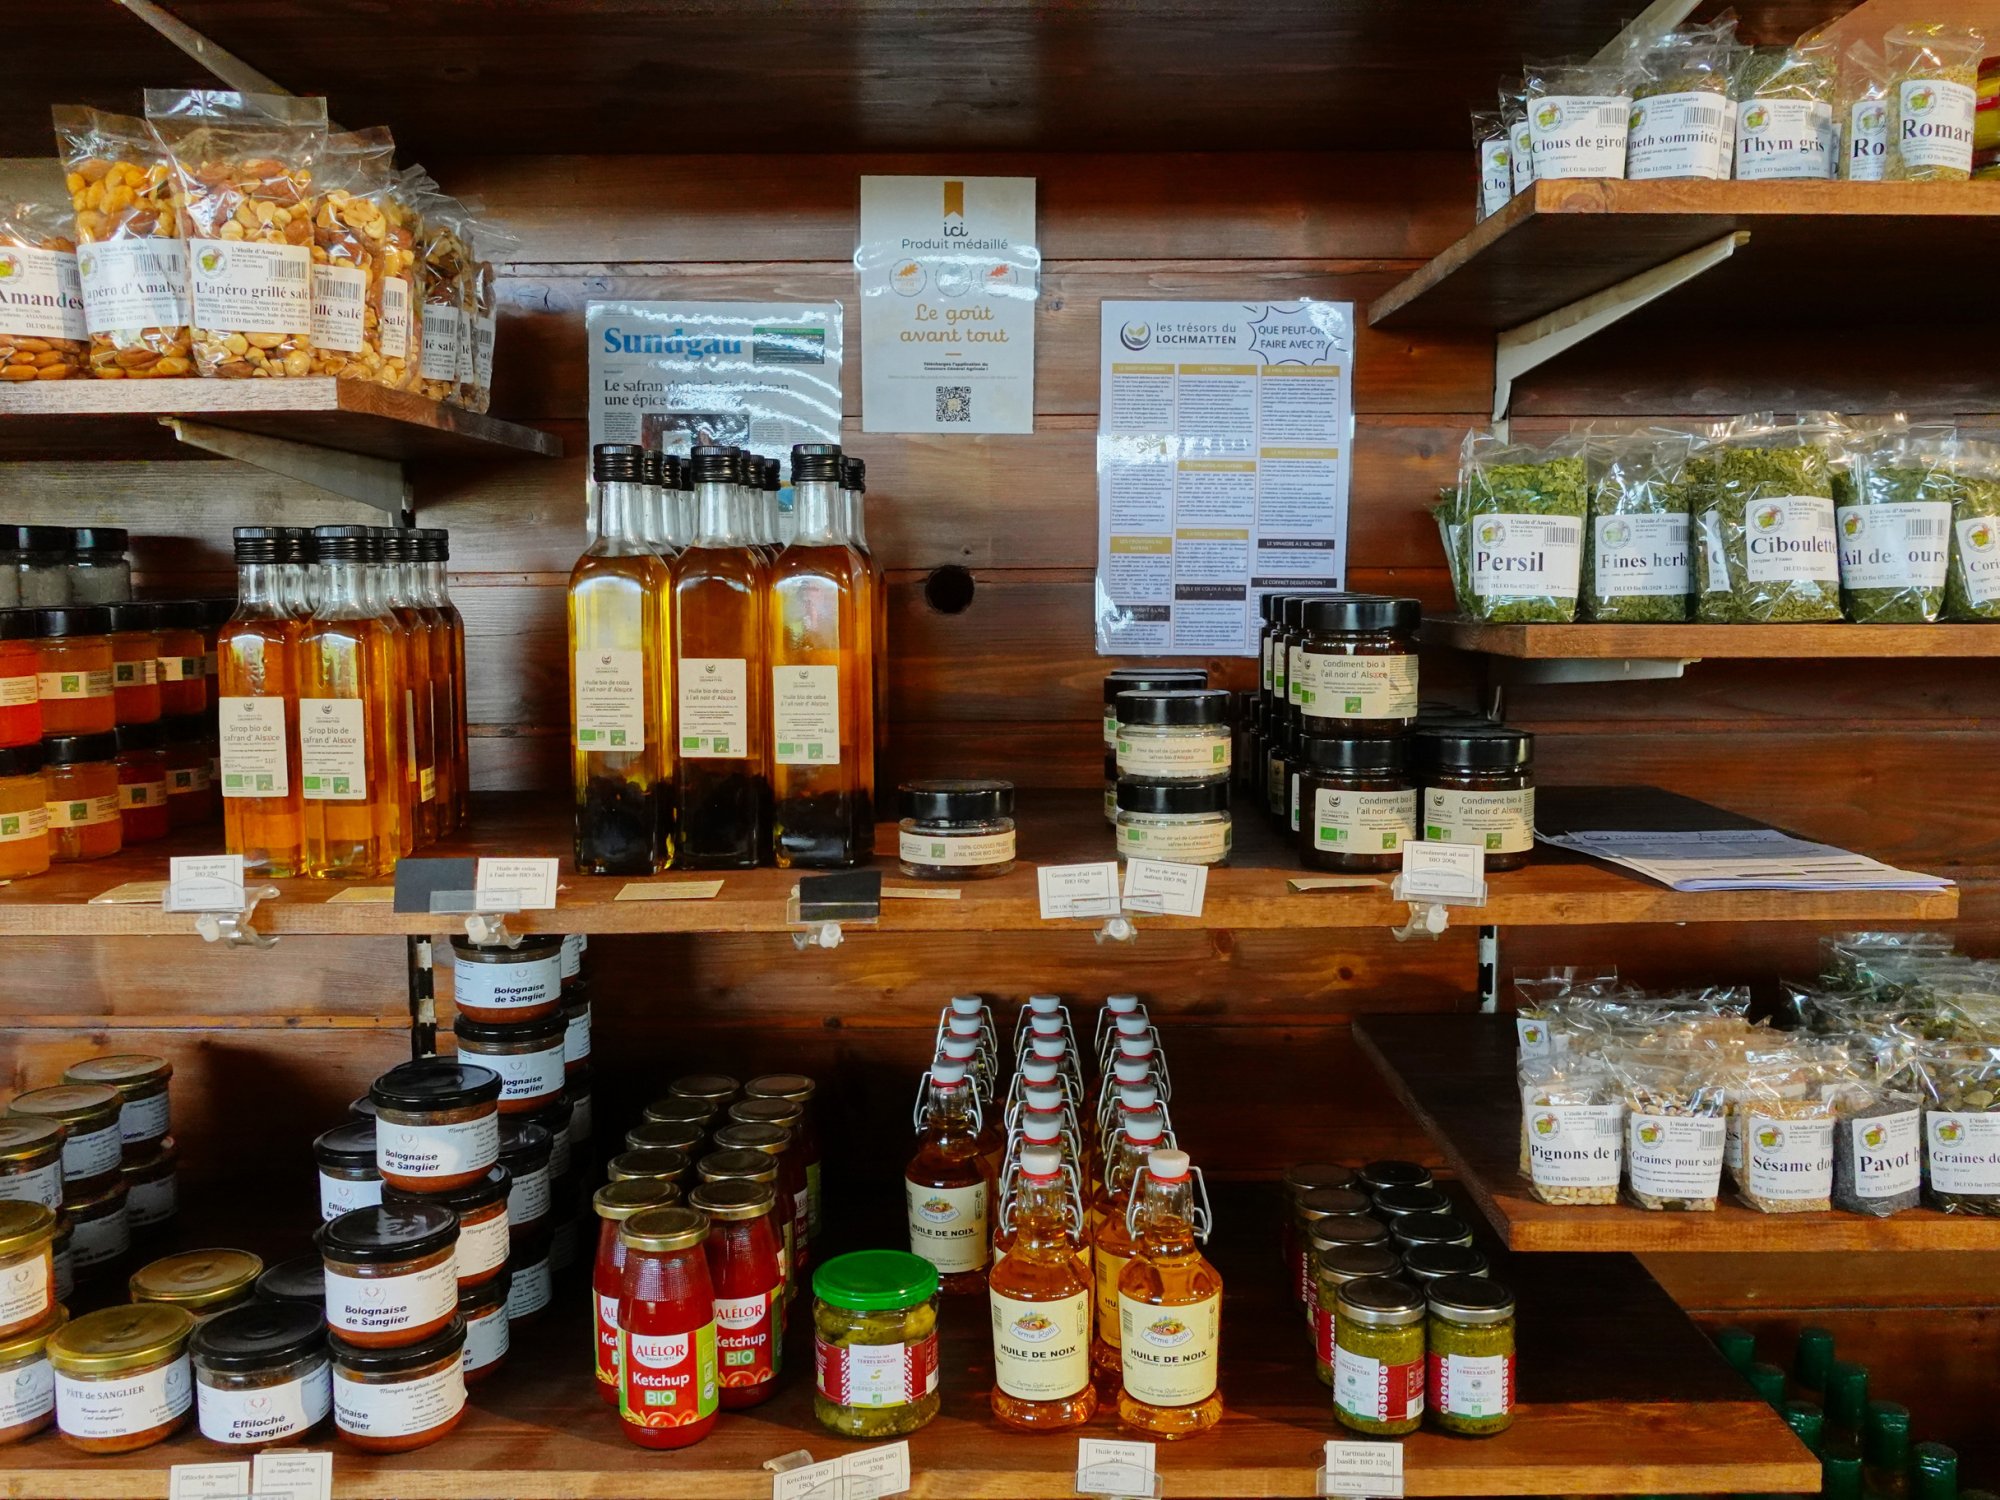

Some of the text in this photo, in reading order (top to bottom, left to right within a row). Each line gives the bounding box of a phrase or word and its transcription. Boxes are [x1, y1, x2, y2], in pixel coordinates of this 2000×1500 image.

[1531, 137, 1571, 154] Clous
[1576, 136, 1592, 148] de
[1740, 137, 1825, 155] Thym gris
[943, 222, 969, 237] ici
[902, 238, 1008, 250] Produit médaillé
[196, 282, 247, 300] L'apéro
[252, 285, 287, 300] grillé
[915, 303, 995, 326] Le goût
[1156, 322, 1236, 333] les trésors du
[1258, 326, 1280, 336] QUE
[900, 328, 1010, 343] avant tout
[1155, 335, 1237, 345] LOCHMATTEN
[604, 327, 743, 361] Sundgau
[1260, 340, 1326, 350] FAIRE AVEC ??
[604, 379, 620, 392] Le
[623, 379, 663, 392] safran
[605, 398, 630, 407] une
[632, 394, 666, 409] épice
[1477, 551, 1545, 572] Persil
[1600, 554, 1647, 569] Fines
[1323, 660, 1364, 669] Condiment
[1366, 660, 1379, 669] bio
[1334, 671, 1349, 680] noir
[1361, 671, 1388, 681] Alsace
[229, 724, 272, 735] Sirop bio de
[308, 727, 350, 738] Sirop bio de
[1359, 796, 1400, 807] Condiment
[1461, 796, 1505, 807] Condiment
[494, 983, 545, 995] Bolognaise
[494, 992, 546, 1004] de Sanglier
[506, 1084, 544, 1094] Sanglier
[385, 1149, 438, 1162] Bolognaise
[1531, 1144, 1589, 1162] Pignons
[1593, 1147, 1609, 1159] de
[1632, 1151, 1671, 1166] Graines
[1675, 1157, 1700, 1169] pour
[1933, 1150, 1985, 1164] Graines
[385, 1160, 440, 1174] de Sanglier
[1752, 1155, 1812, 1173] Sésame
[911, 1222, 933, 1236] HUILE
[950, 1226, 976, 1237] NOIX
[345, 1305, 407, 1317] Bolognaise
[716, 1303, 763, 1320] ALÉLOR
[346, 1315, 411, 1327] de Sanglier
[635, 1341, 686, 1358] ALÉLOR
[725, 1349, 754, 1365] BIO
[1000, 1343, 1077, 1359] HUILE DE NOIX
[1130, 1347, 1208, 1364] HUILE DE NOIX
[632, 1371, 690, 1387] Ketchup
[86, 1391, 96, 1401] de
[98, 1385, 145, 1400] SANGLIER
[646, 1390, 676, 1406] BIO
[232, 1414, 286, 1428] Effiloché
[228, 1422, 296, 1440] de Sanglier
